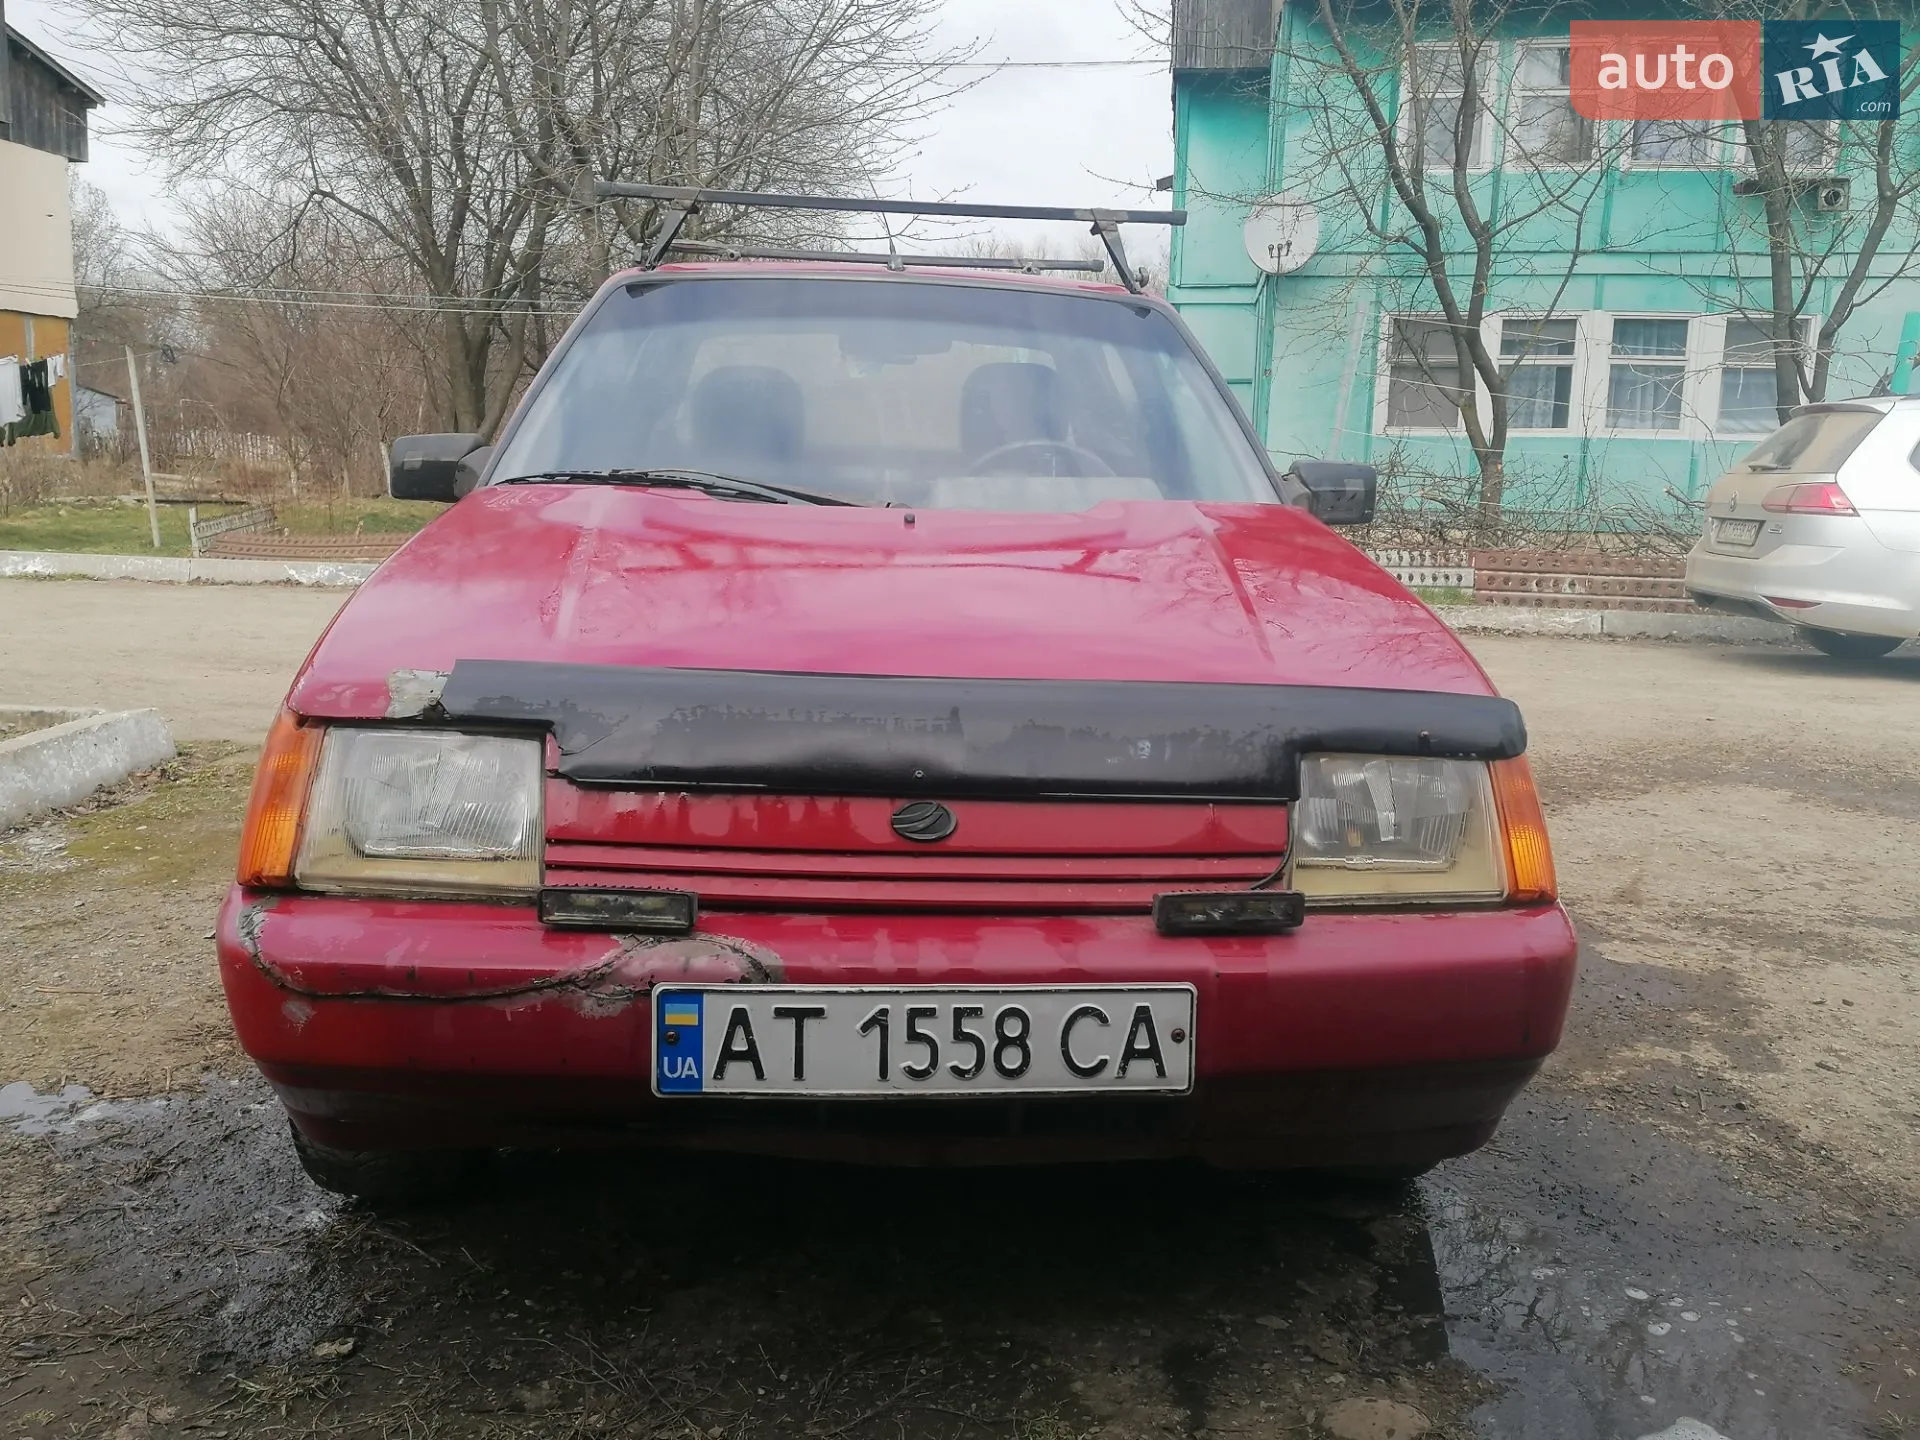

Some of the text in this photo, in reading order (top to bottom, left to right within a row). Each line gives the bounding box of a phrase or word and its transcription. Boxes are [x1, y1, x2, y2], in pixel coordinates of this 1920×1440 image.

[712, 1003, 1168, 1080] AT 1558 CA
[663, 1056, 698, 1079] UA
